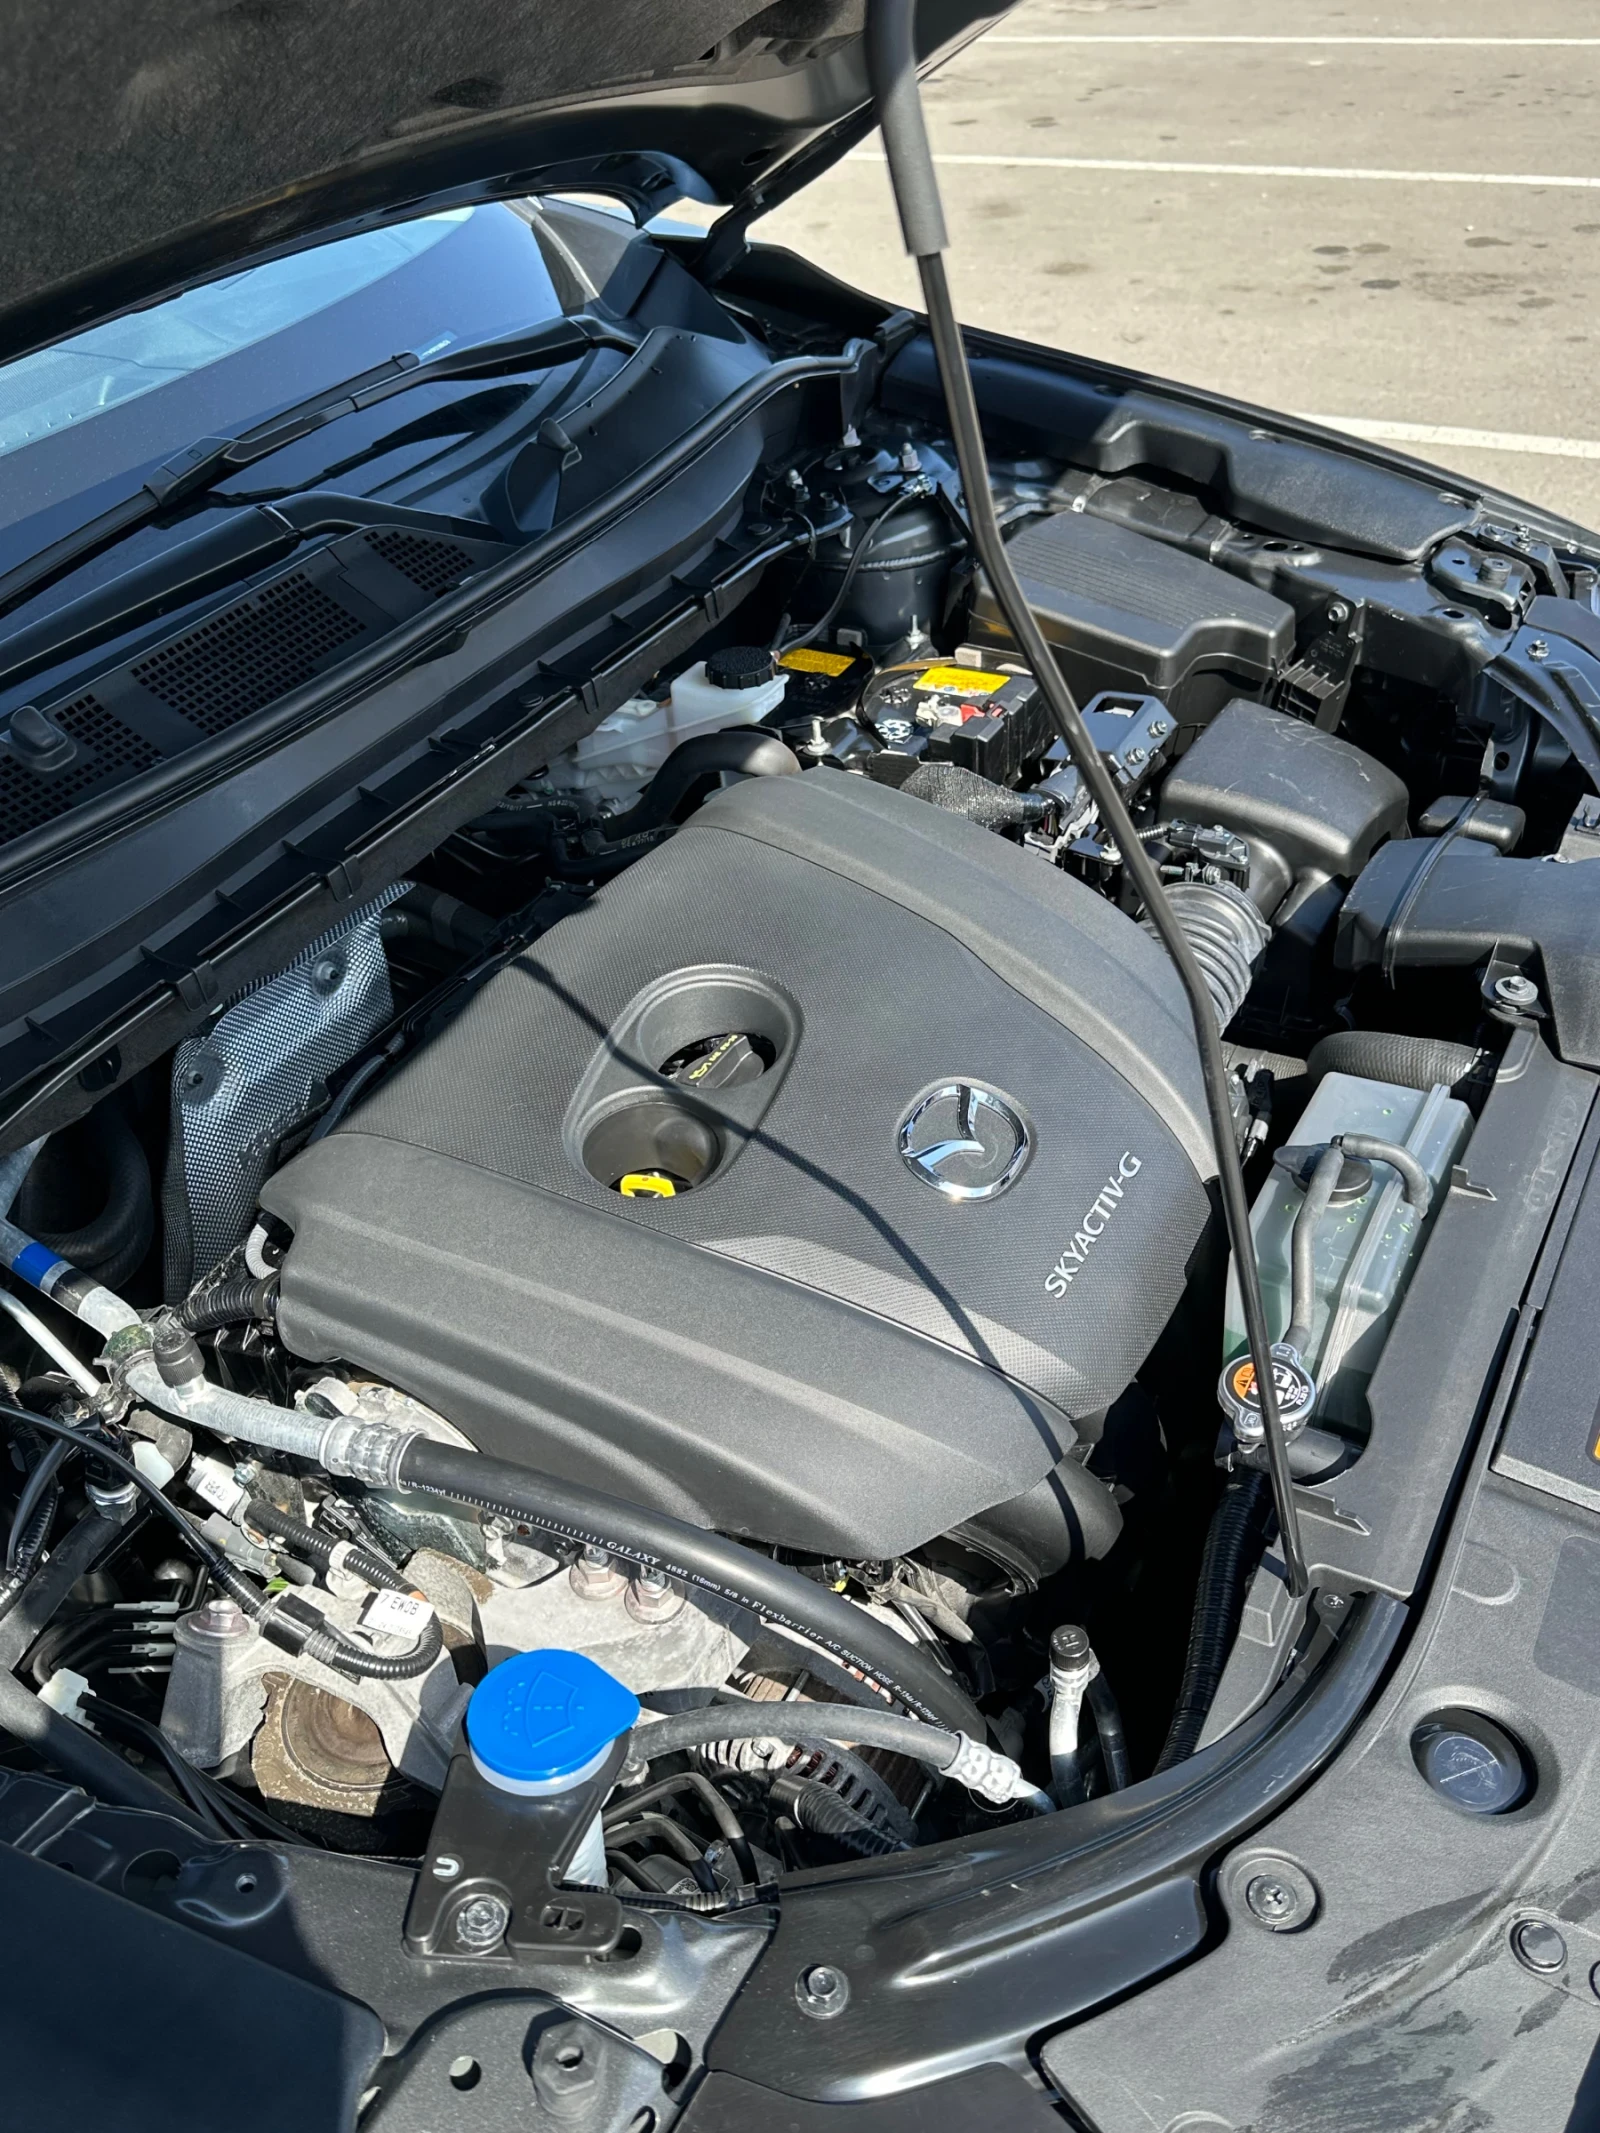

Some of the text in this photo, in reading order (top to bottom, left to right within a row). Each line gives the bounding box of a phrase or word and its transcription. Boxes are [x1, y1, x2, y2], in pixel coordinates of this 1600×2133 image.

[1044, 1151, 1142, 1299] SKYACTIV-G
[606, 1541, 661, 1565] GALAXY
[665, 1563, 689, 1577] 4882
[752, 1601, 824, 1641] Flexbarrier
[825, 1640, 842, 1652] A/C
[840, 1649, 874, 1672] SUCTION
[873, 1670, 894, 1686] HOSE
